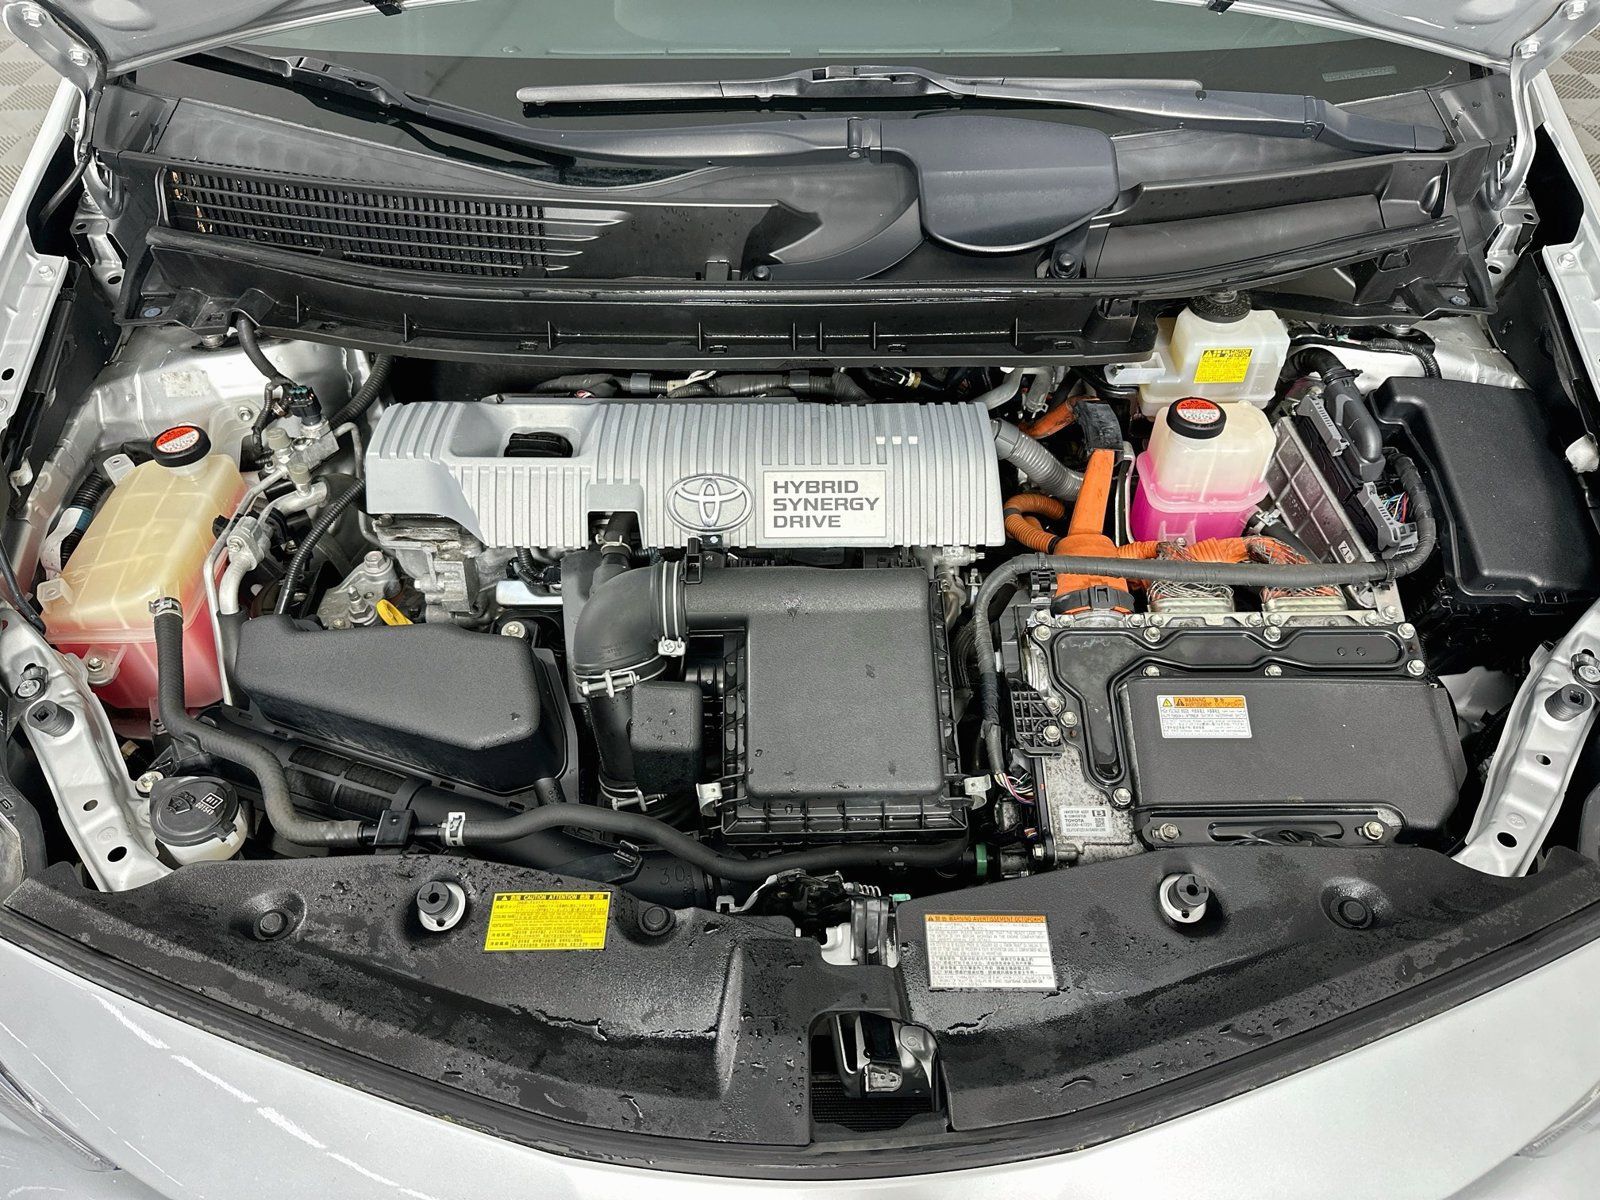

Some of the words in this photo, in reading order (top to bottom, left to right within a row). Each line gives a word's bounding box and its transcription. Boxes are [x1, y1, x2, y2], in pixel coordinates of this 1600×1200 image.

[773, 480, 859, 494] HYBRID
[773, 497, 880, 511] SYNERGY
[773, 515, 841, 528] DRIVE
